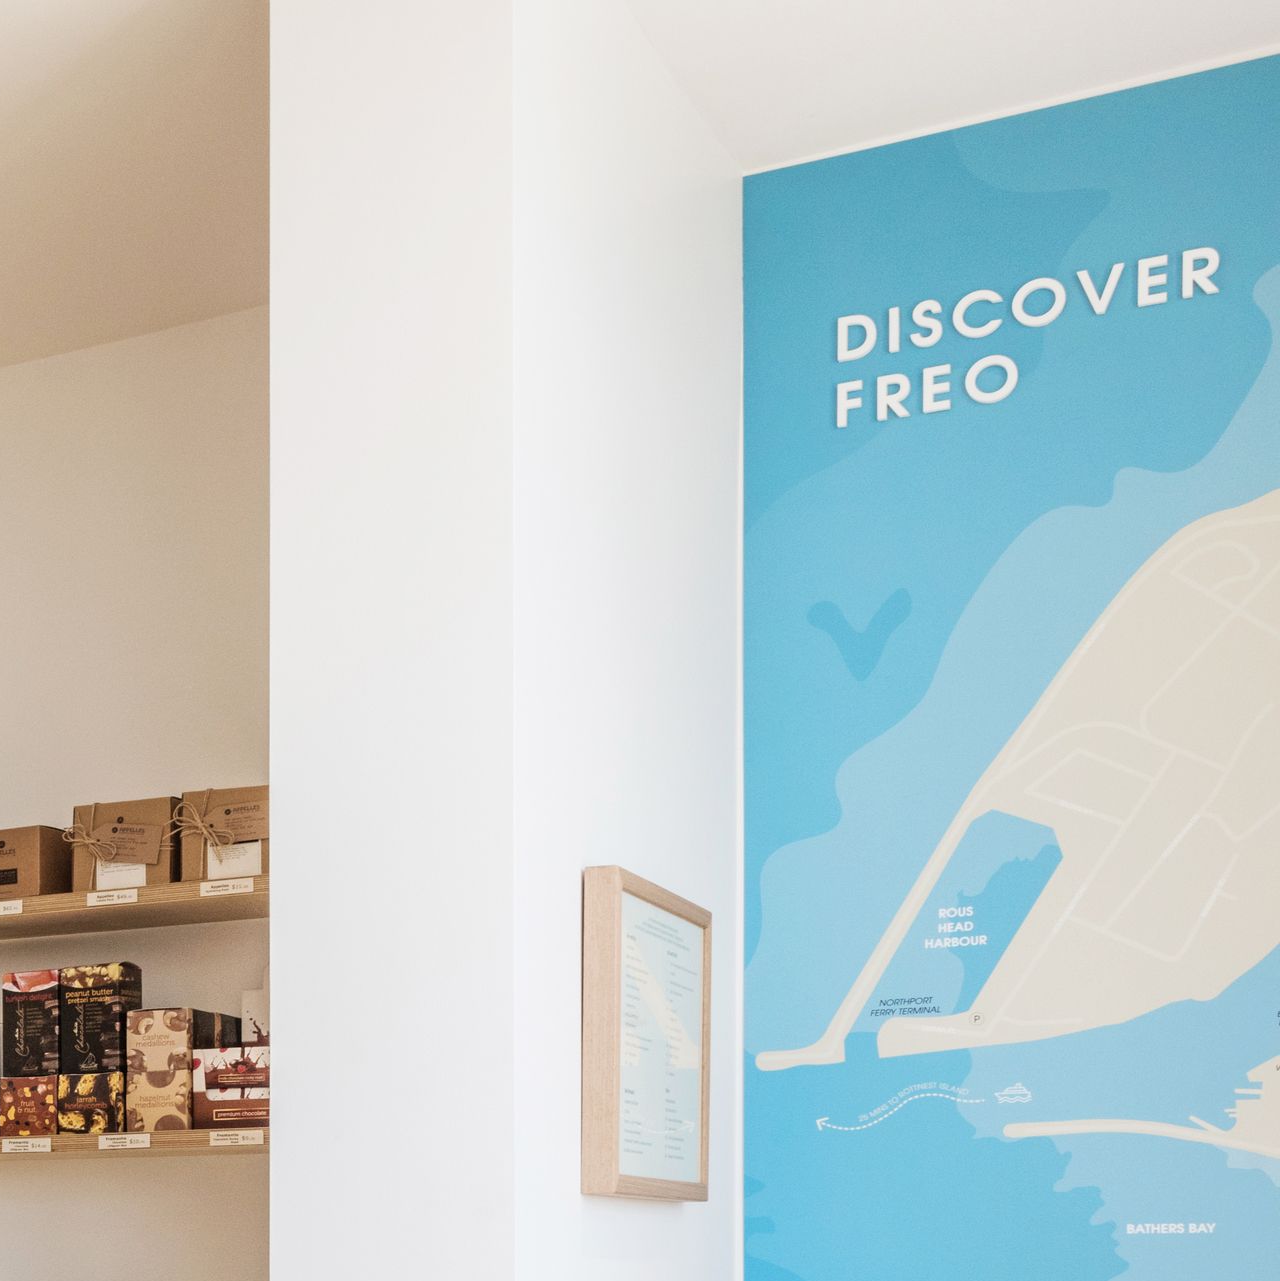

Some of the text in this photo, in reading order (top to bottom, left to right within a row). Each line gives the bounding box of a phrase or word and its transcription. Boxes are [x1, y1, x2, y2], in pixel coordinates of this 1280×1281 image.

[836, 246, 1221, 363] DISCOVER
[836, 354, 1019, 429] FREO
[938, 906, 974, 918] ROUS
[937, 920, 974, 933] HEAD
[924, 934, 988, 949] HARBOUR
[66, 988, 113, 999] peanut butter
[879, 997, 933, 1007] NORTHPORT
[870, 1006, 942, 1017] FERRY TERMINAL
[136, 1038, 176, 1047] medallions
[142, 1033, 170, 1041] cashew
[939, 1083, 969, 1095] ISLAND
[76, 1095, 97, 1103] jarrah
[1126, 1223, 1216, 1236] BATHERS BAY
